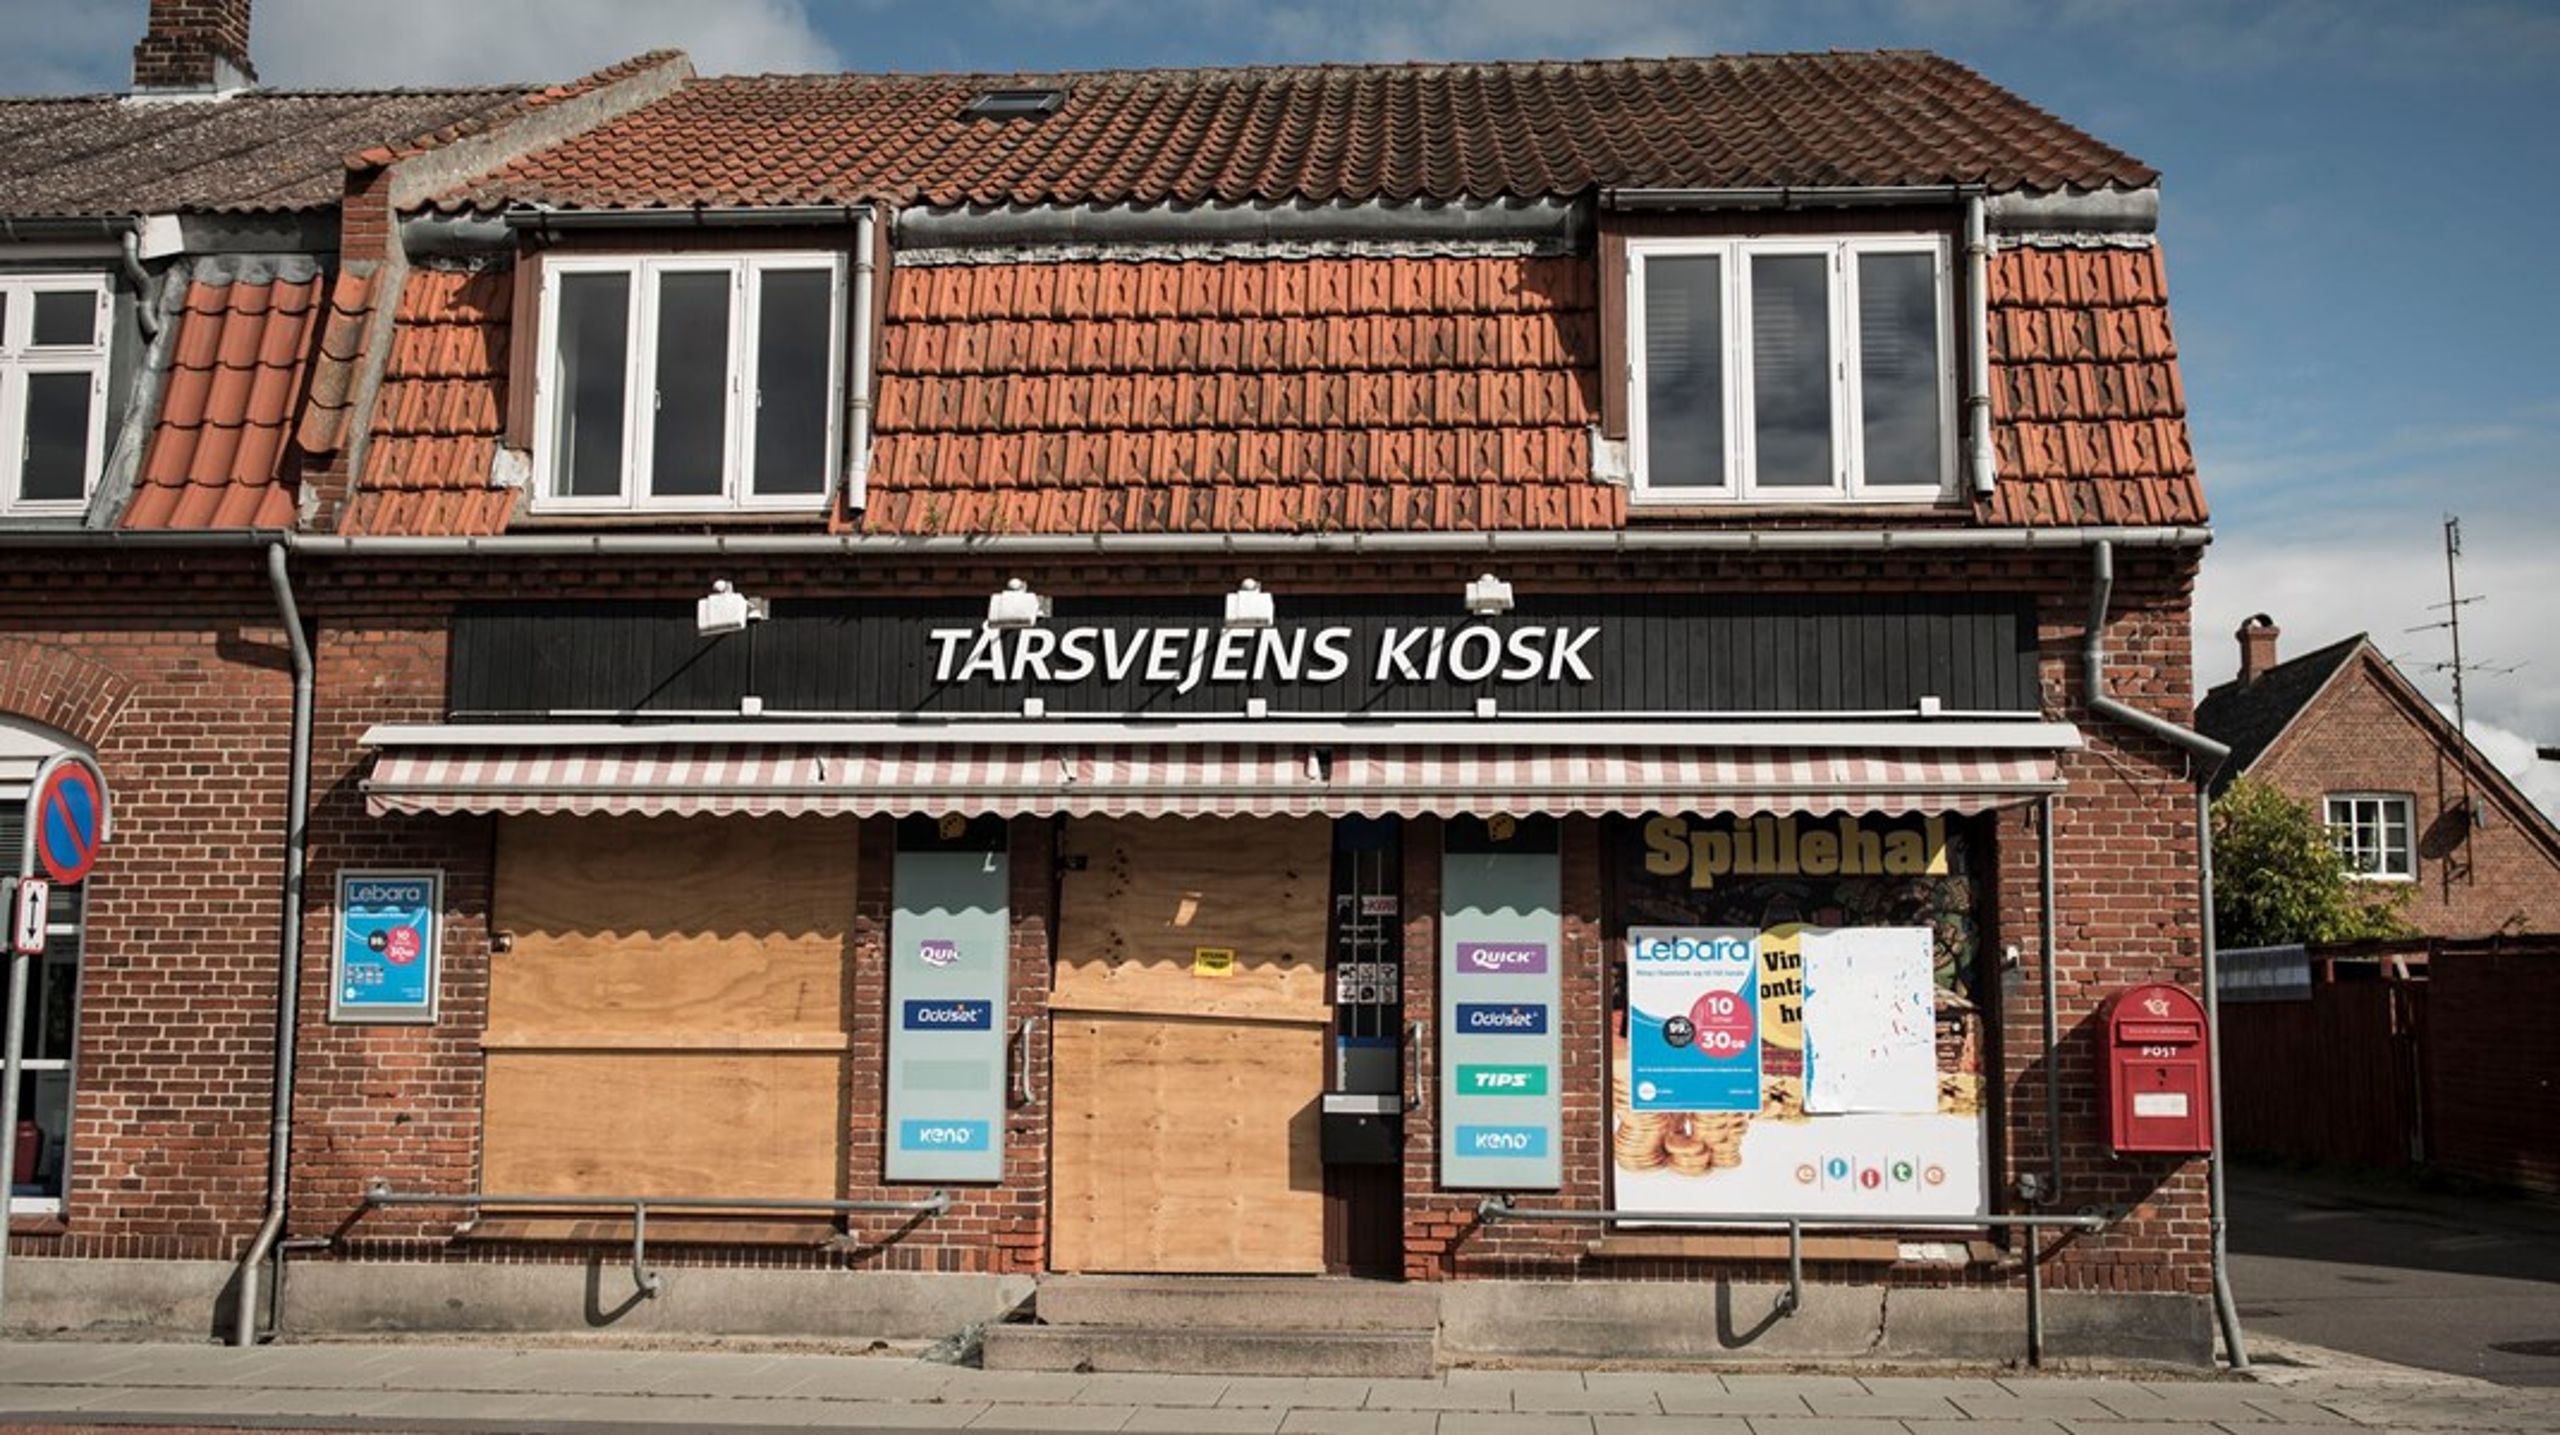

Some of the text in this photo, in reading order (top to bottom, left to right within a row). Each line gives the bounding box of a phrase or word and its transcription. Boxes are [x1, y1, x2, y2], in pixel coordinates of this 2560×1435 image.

[1375, 626, 1600, 681] KIOSK
[1643, 816, 1948, 888] Spillehal
[349, 884, 420, 902] Lebara
[1636, 935, 1750, 961] Lebara
[918, 1007, 977, 1022] Oddset
[1708, 997, 1734, 1015] 10
[1471, 1011, 1532, 1026] Oddset
[2142, 1046, 2176, 1057] POST
[1475, 1073, 1528, 1087] TIPS
